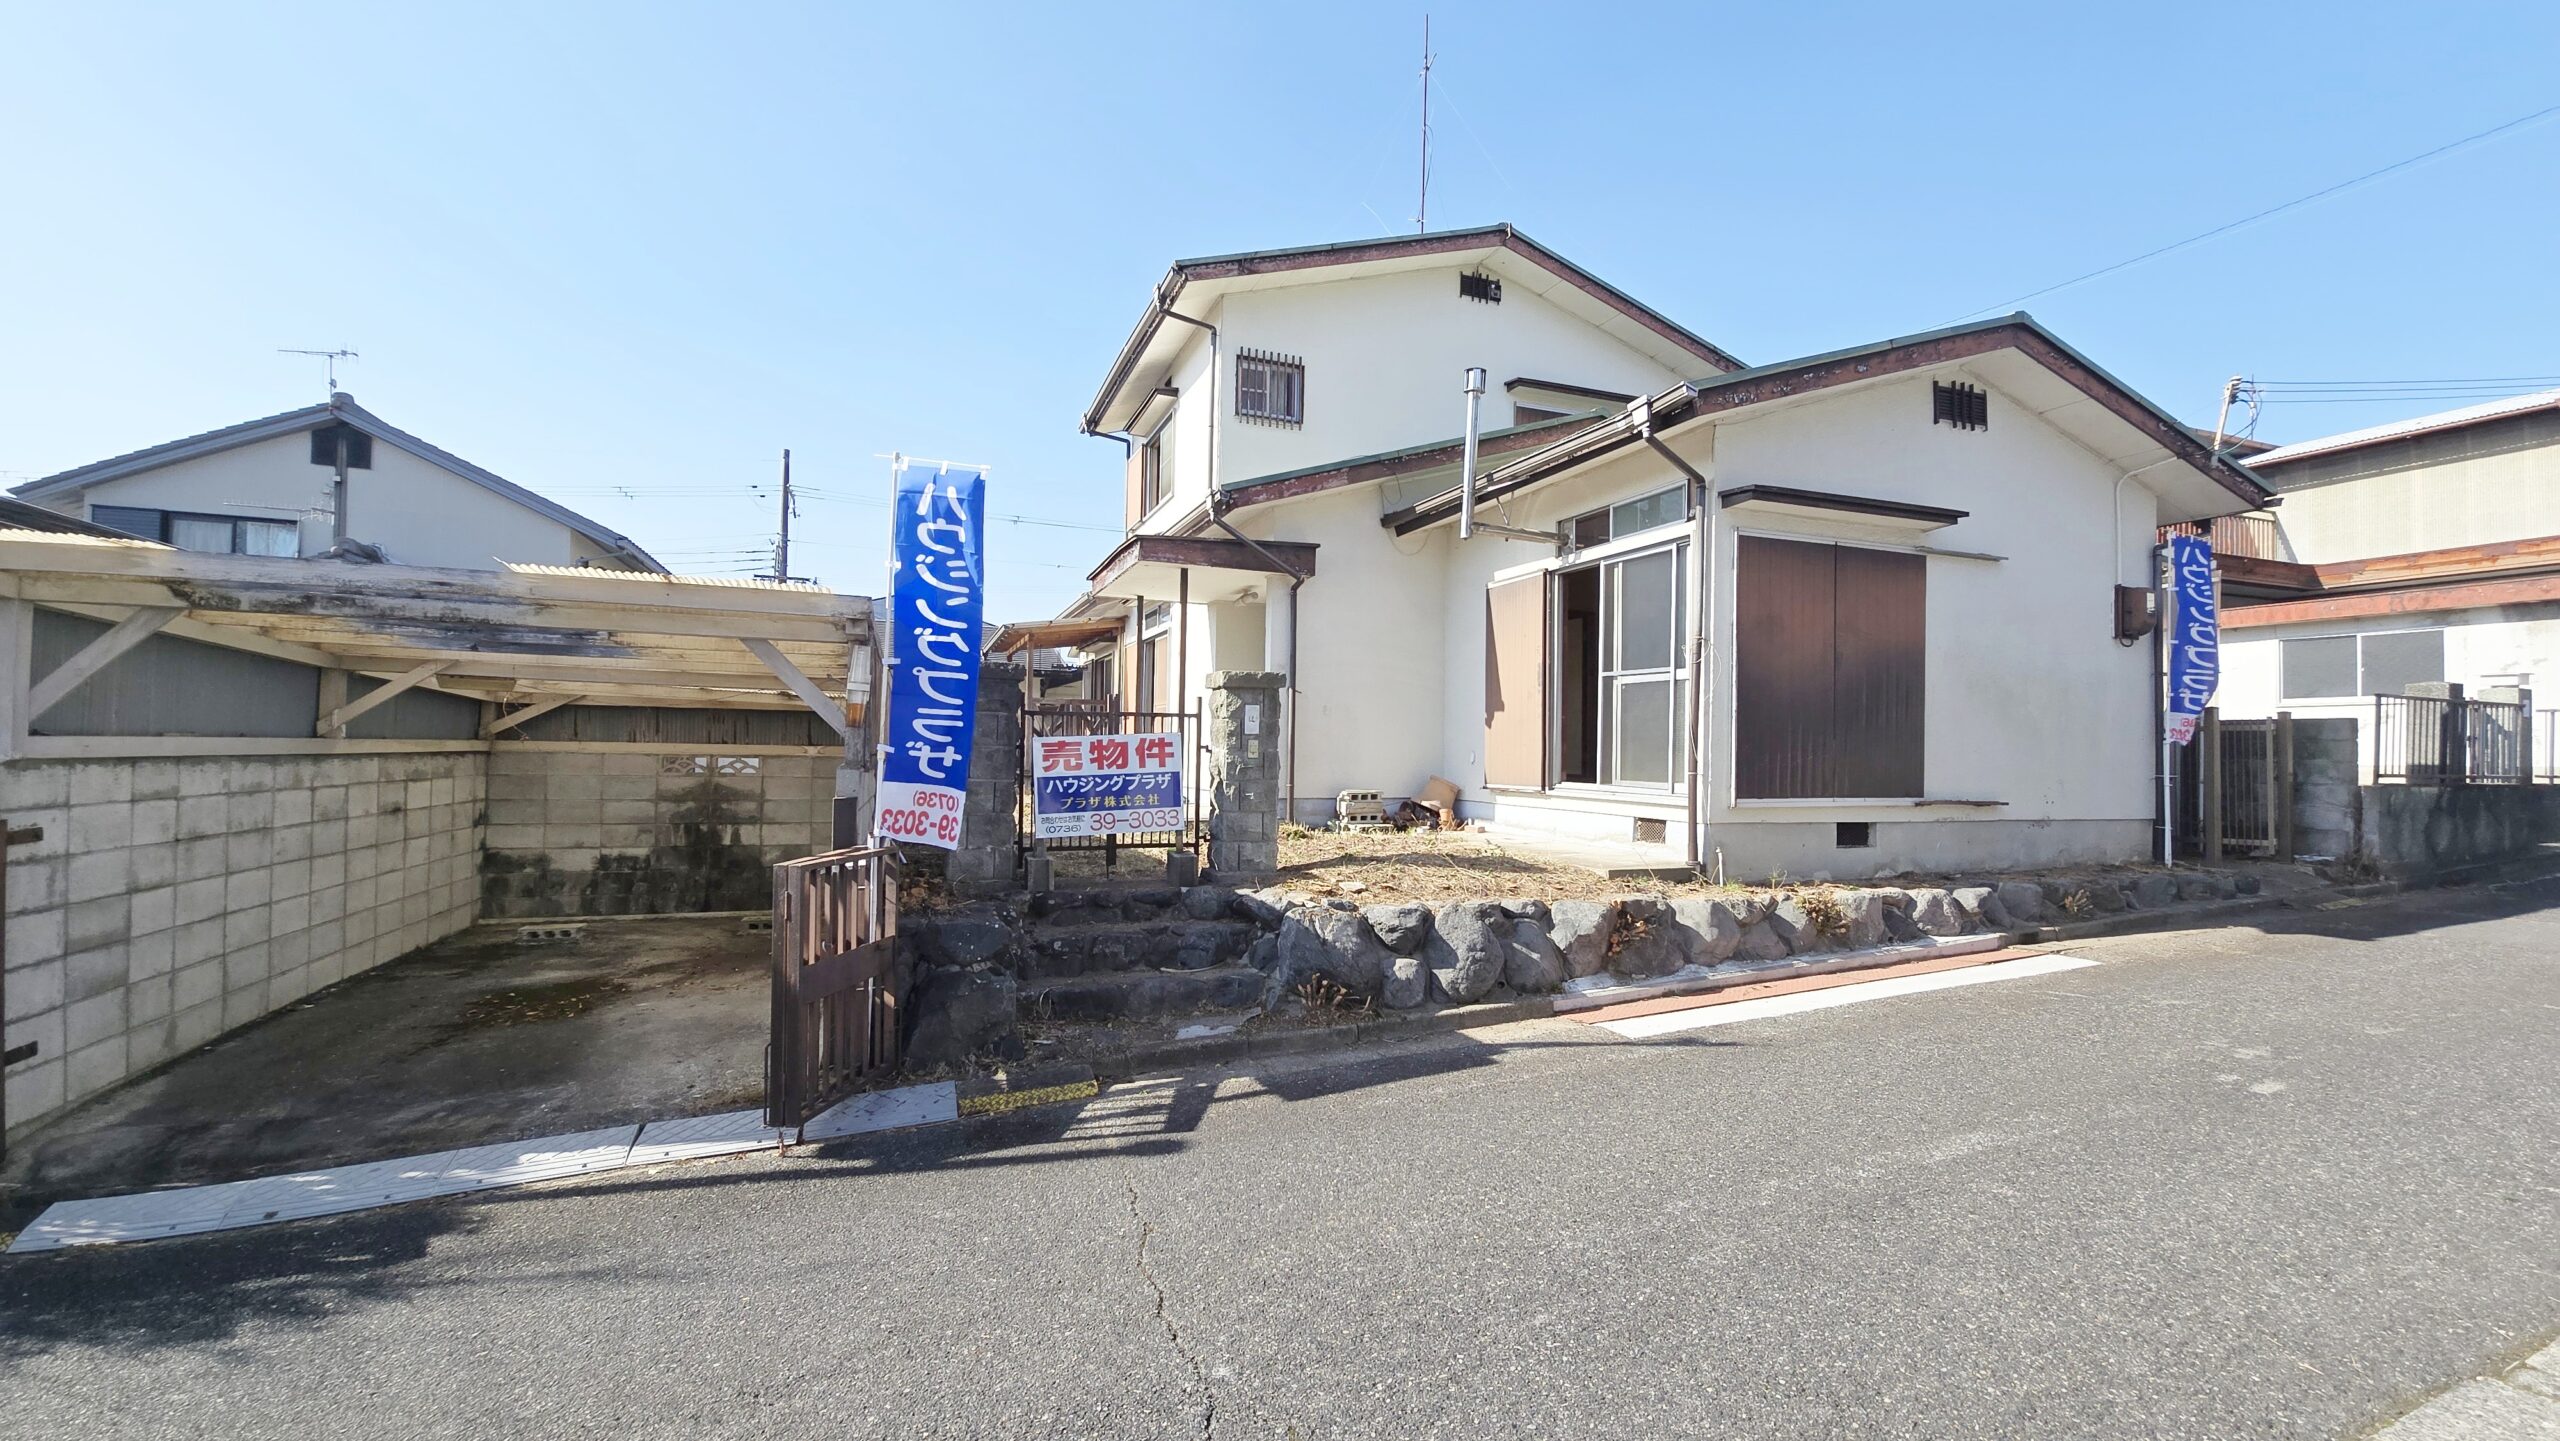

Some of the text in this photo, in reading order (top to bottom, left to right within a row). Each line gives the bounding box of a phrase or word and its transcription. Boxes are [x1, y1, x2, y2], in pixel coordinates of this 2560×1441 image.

[1040, 737, 1175, 772] 売物件
[1046, 773, 1172, 794] ハウジングプラザ
[1061, 794, 1161, 809] プラザ株式会社
[1046, 825, 1081, 834] (0736)
[1090, 809, 1180, 832] 39-3033
